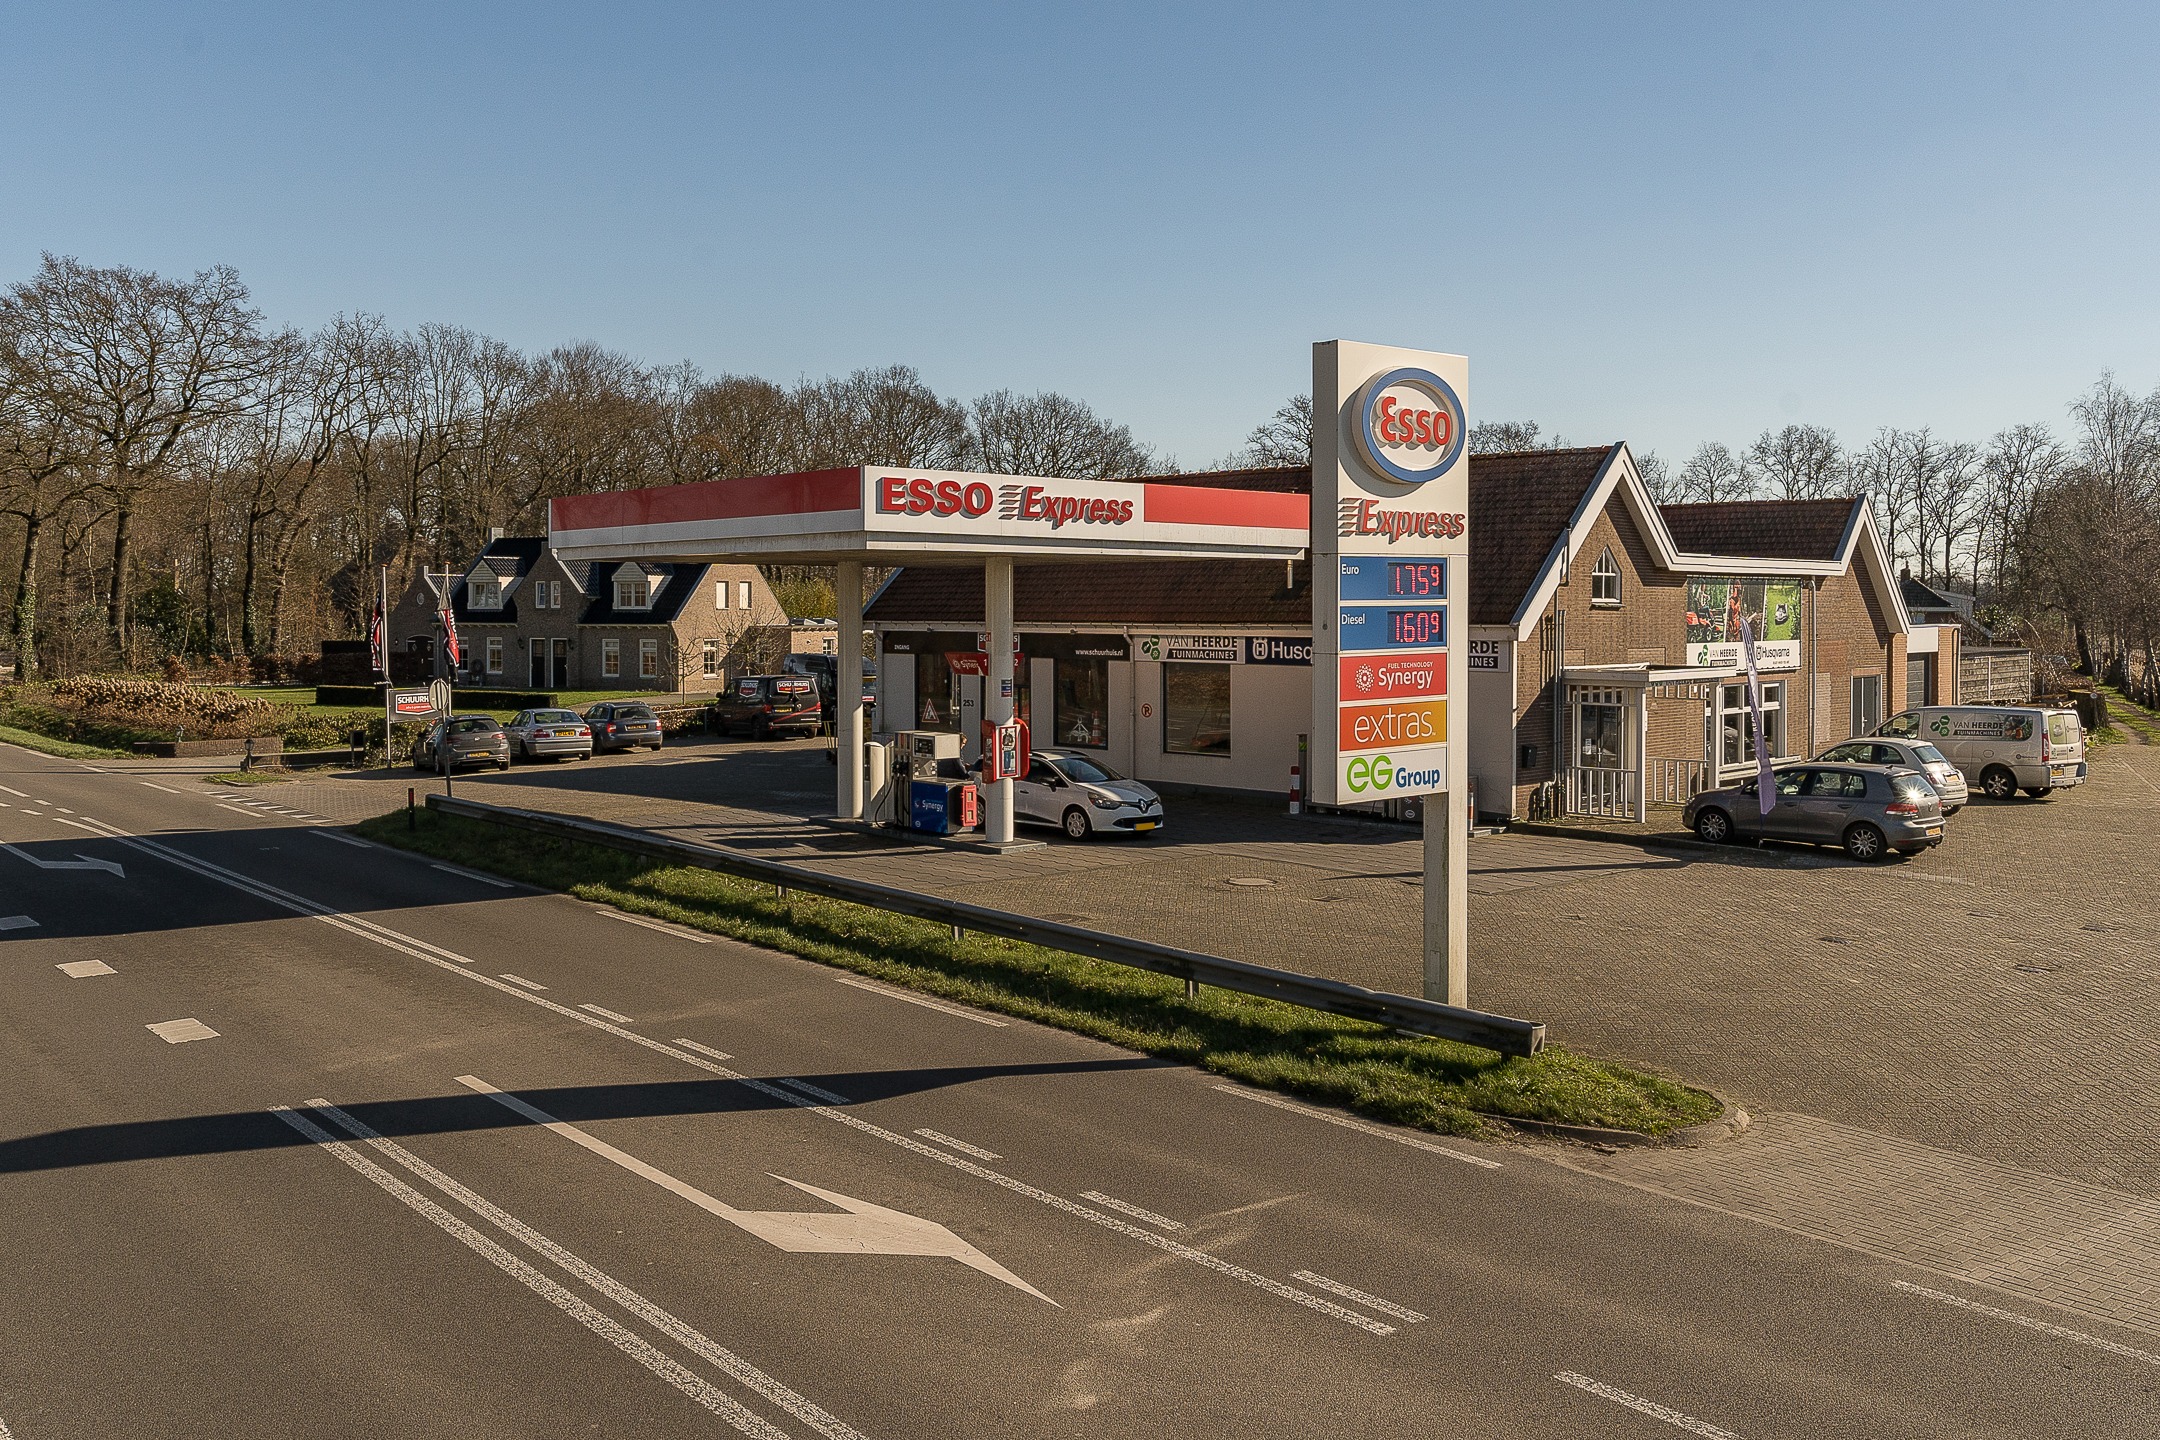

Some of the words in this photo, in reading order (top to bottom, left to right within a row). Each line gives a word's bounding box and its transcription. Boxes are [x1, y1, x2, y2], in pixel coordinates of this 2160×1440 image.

[1380, 396, 1450, 446] Esso
[878, 477, 993, 517] ESSO
[1019, 486, 1134, 528] Express
[1358, 499, 1466, 542] Express
[1341, 563, 1360, 575] Euro
[1395, 565, 1440, 595] 1.759
[1341, 613, 1366, 625] Diesel
[1395, 612, 1440, 643] 1.609
[1166, 636, 1189, 647] VAN
[1192, 636, 1238, 648] HEERDE
[1172, 650, 1235, 659] TUINMACHINES
[1719, 648, 1738, 657] HEERDE
[1761, 646, 1790, 659] Husqvarna
[1400, 661, 1434, 669] TECHNOLOGY
[1378, 668, 1434, 691] Synergy
[397, 695, 429, 704] SCHUURH
[962, 699, 974, 707] 253
[1354, 707, 1433, 743] extras
[1953, 721, 1970, 729] VAN
[1971, 721, 2004, 730] HEERDE
[1395, 767, 1441, 789] Group
[922, 799, 944, 812] Synergy
